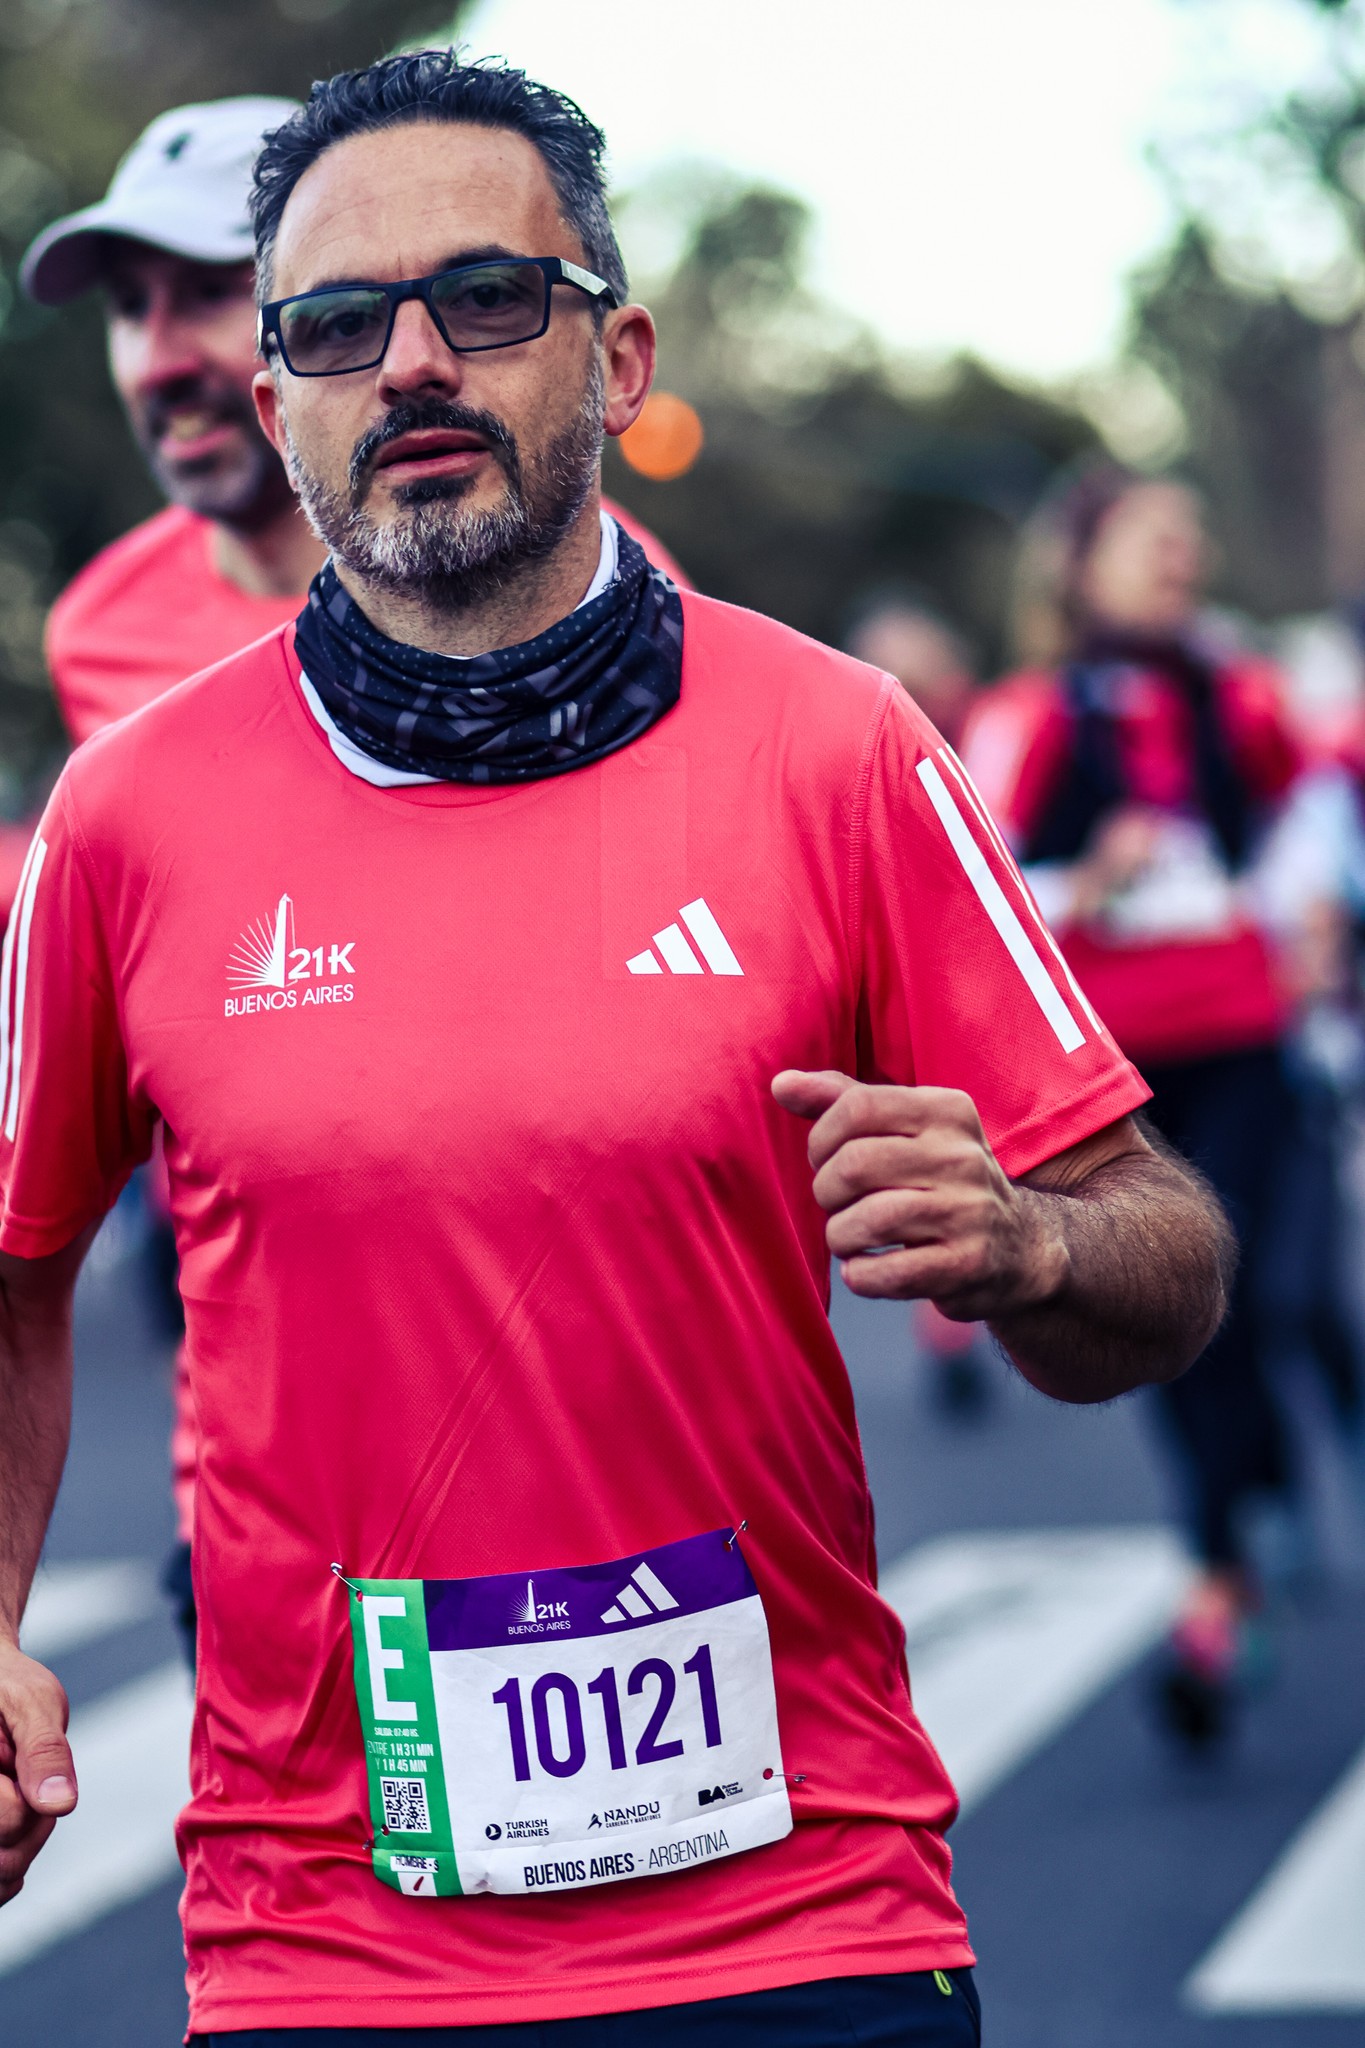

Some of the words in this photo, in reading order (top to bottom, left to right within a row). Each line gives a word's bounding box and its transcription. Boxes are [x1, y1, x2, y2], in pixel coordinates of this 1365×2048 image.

[288, 942, 356, 980] 21K
[224, 989, 298, 1017] BUENOS
[301, 983, 355, 1006] AIRES
[536, 1601, 570, 1620] 21K
[507, 1623, 545, 1635] BUENOS
[546, 1620, 572, 1631] AIRES
[362, 1595, 418, 1721] E
[492, 1643, 722, 1782] 10121
[416, 1743, 434, 1757] MIN
[409, 1759, 428, 1773] MIN
[505, 1818, 548, 1830] TURKISH
[605, 1819, 630, 1829] CARRERAS
[635, 1813, 661, 1824] MARATONES
[506, 1828, 550, 1839] AIRLINES
[523, 1860, 586, 1887] BUENOS
[590, 1852, 635, 1879] AIRES
[649, 1829, 730, 1869] ARGENTINA
